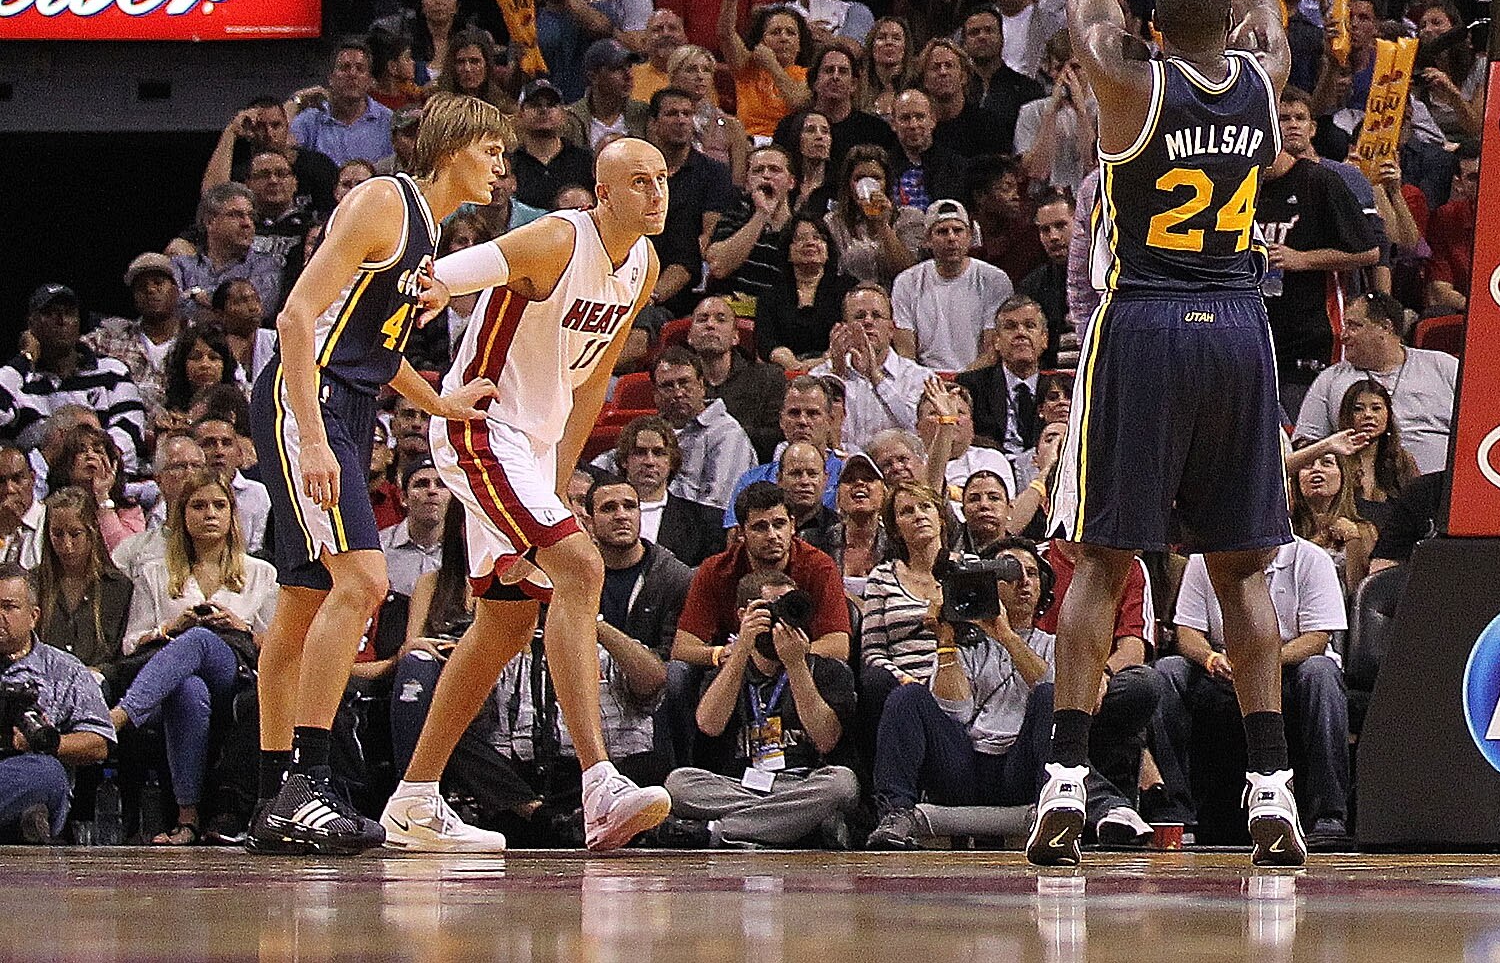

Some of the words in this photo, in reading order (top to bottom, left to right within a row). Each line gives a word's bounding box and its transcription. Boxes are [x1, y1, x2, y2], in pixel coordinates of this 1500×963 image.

[1164, 124, 1264, 161] MILLSAP
[1146, 165, 1260, 253] 24
[561, 298, 635, 335] HEAT
[1184, 310, 1215, 324] UTAH
[569, 338, 611, 370] 11
